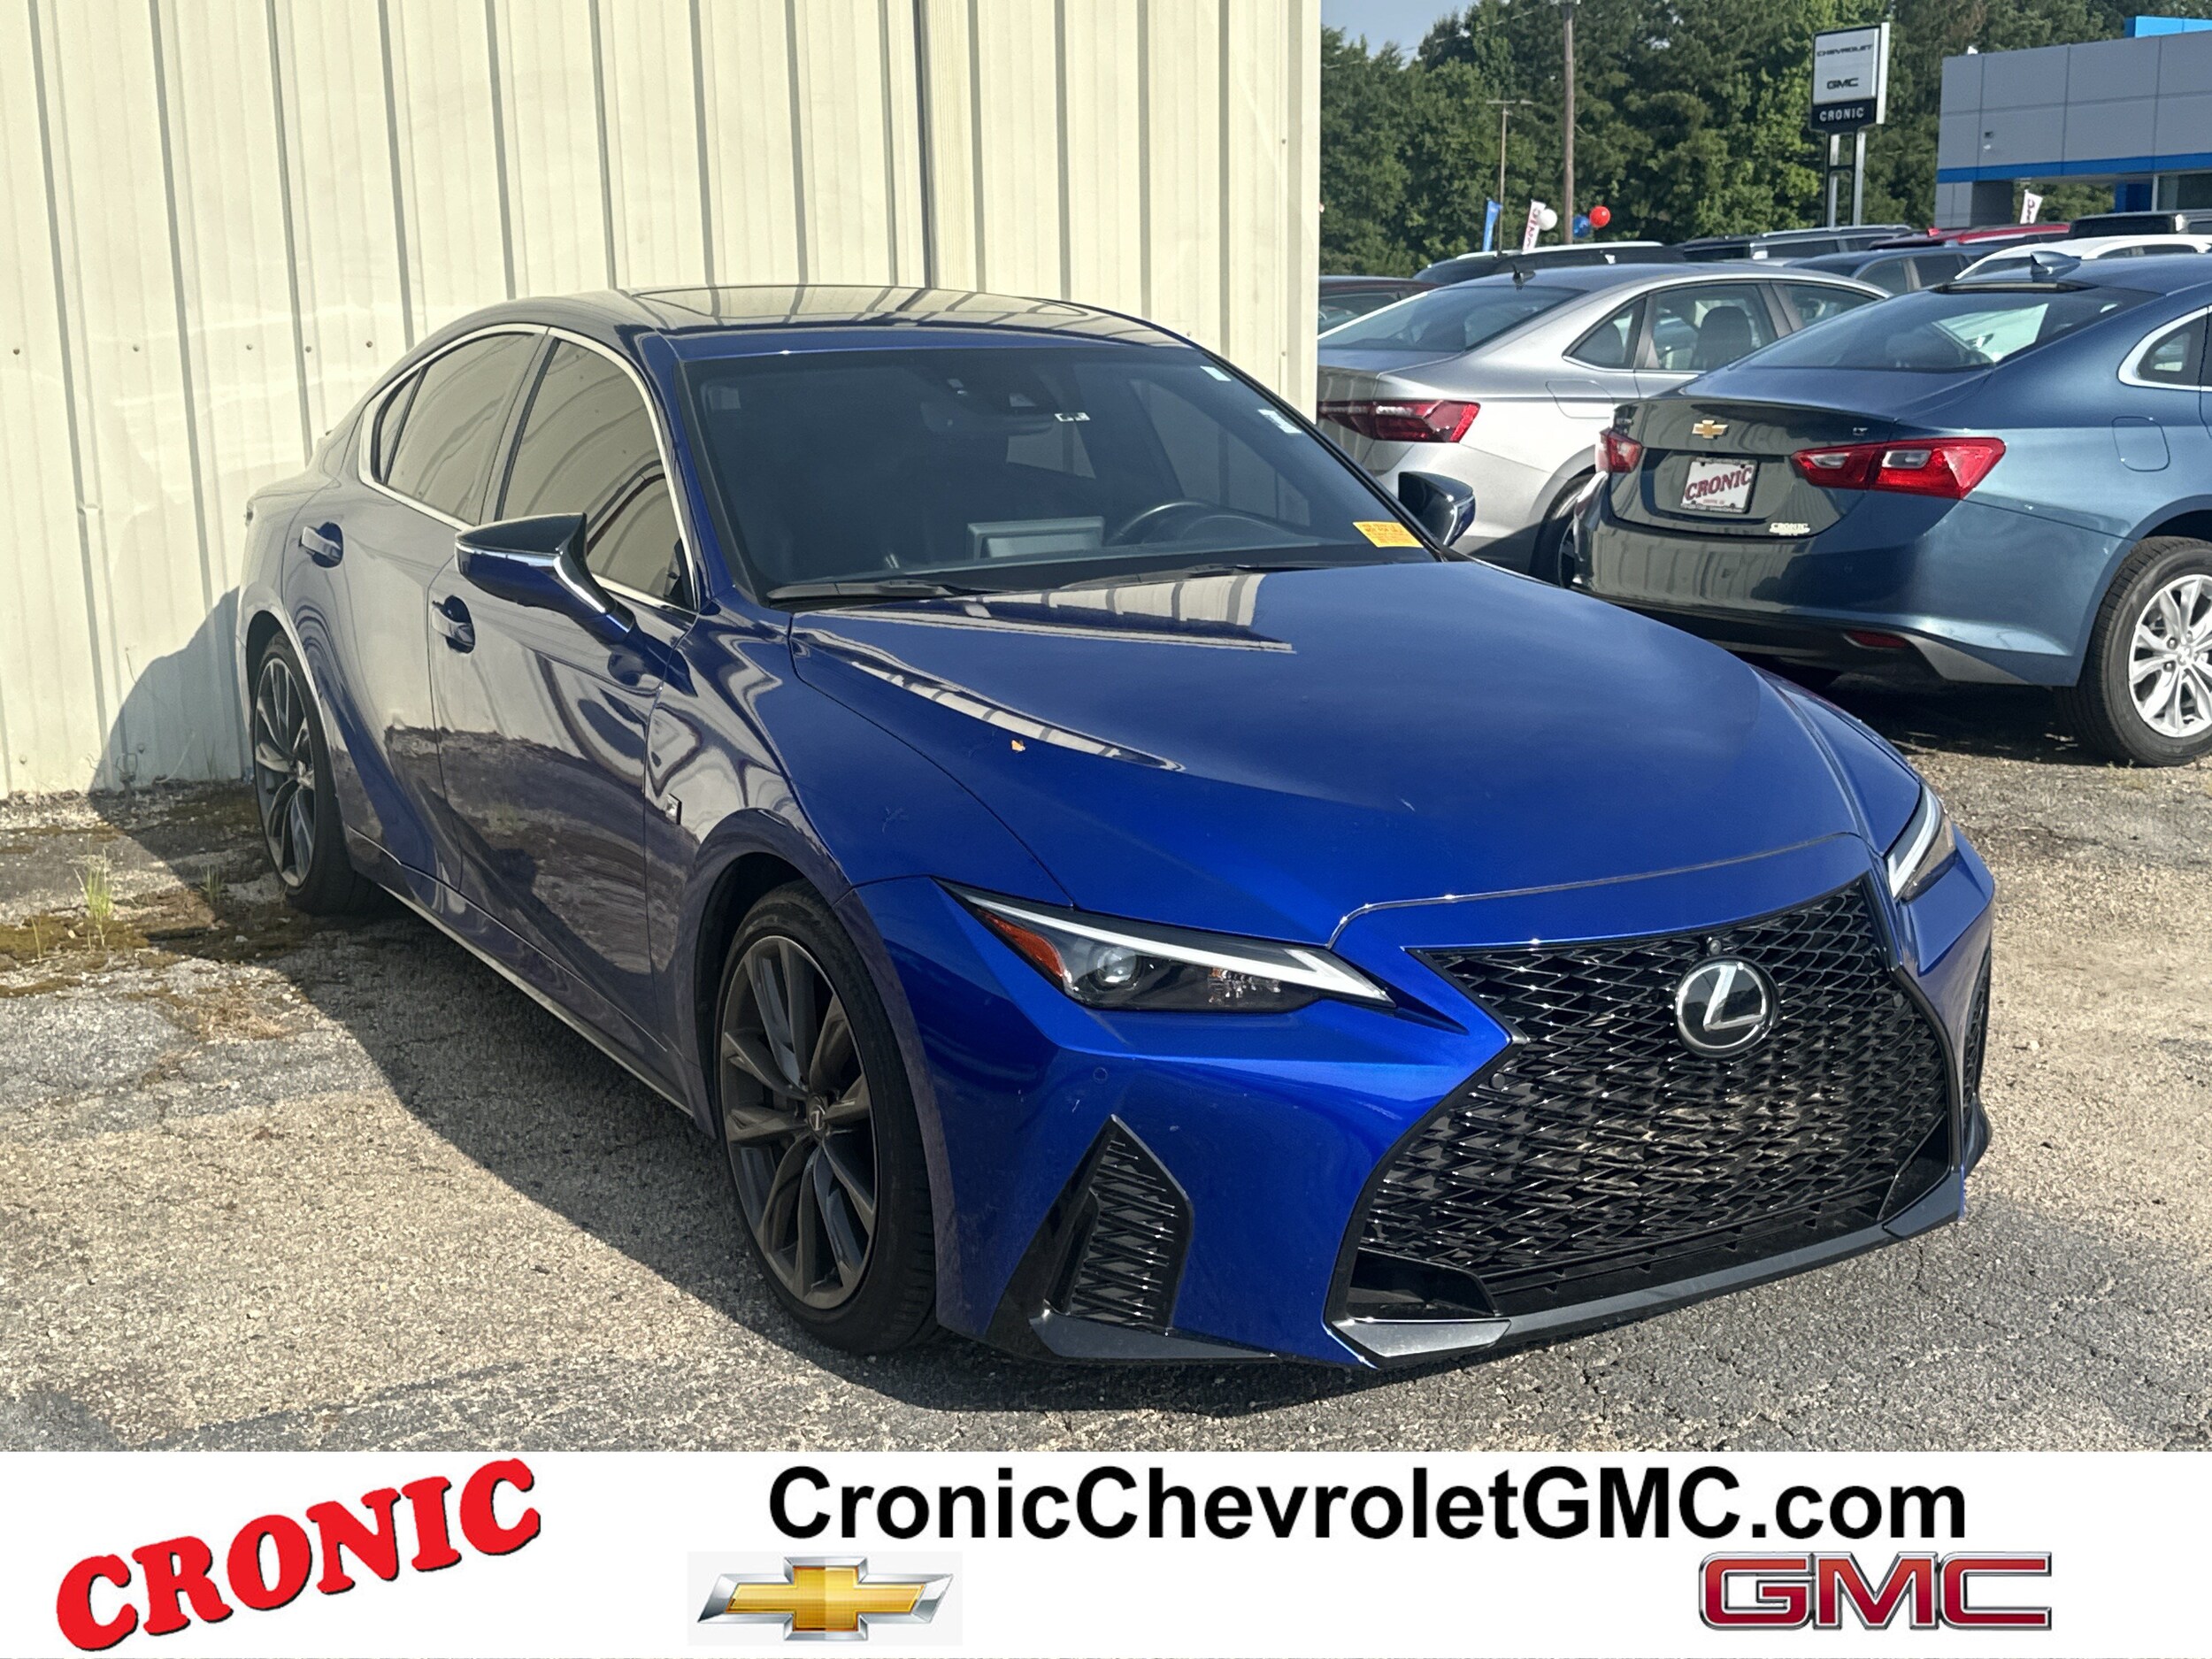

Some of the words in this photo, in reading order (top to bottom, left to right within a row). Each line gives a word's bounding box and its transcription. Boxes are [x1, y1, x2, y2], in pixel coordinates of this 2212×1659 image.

[1816, 44, 1873, 57] CHEVROLET
[1826, 77, 1859, 90] GMC
[1819, 107, 1865, 122] CRONIC
[1685, 467, 1752, 501] CRONIC
